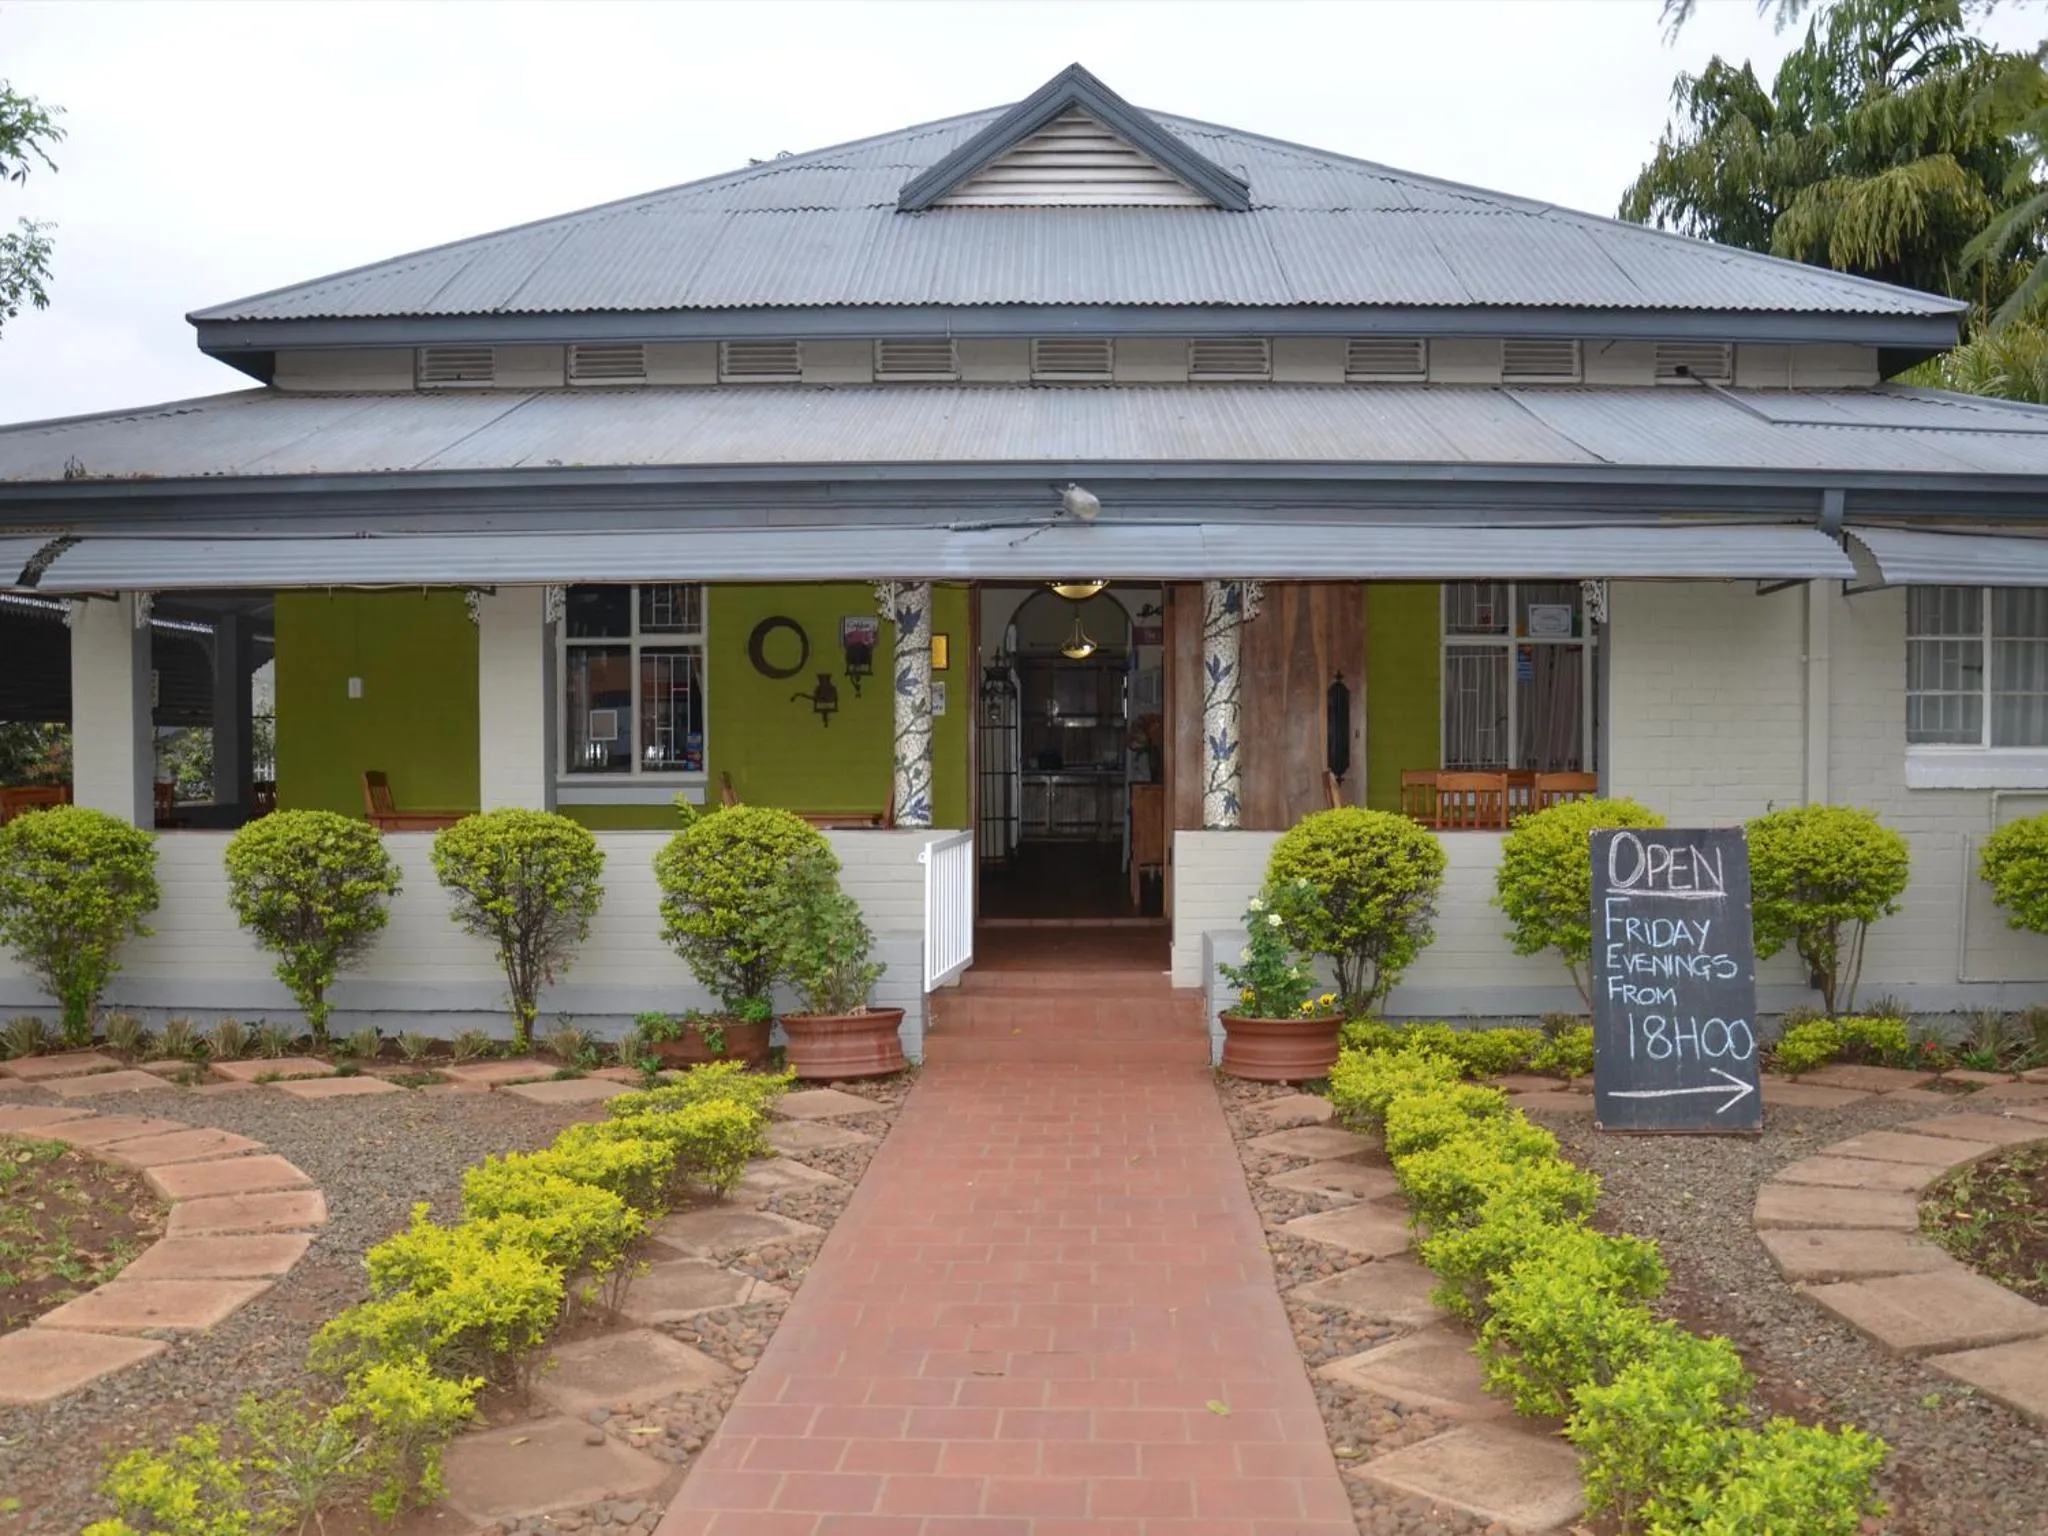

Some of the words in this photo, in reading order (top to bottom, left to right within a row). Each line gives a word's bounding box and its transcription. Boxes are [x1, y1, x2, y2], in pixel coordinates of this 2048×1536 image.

[1608, 831, 1724, 890] OPEN
[1605, 897, 1710, 952] FRIDAY
[1606, 943, 1738, 981] EVENINGS
[1608, 975, 1677, 1007] FROM
